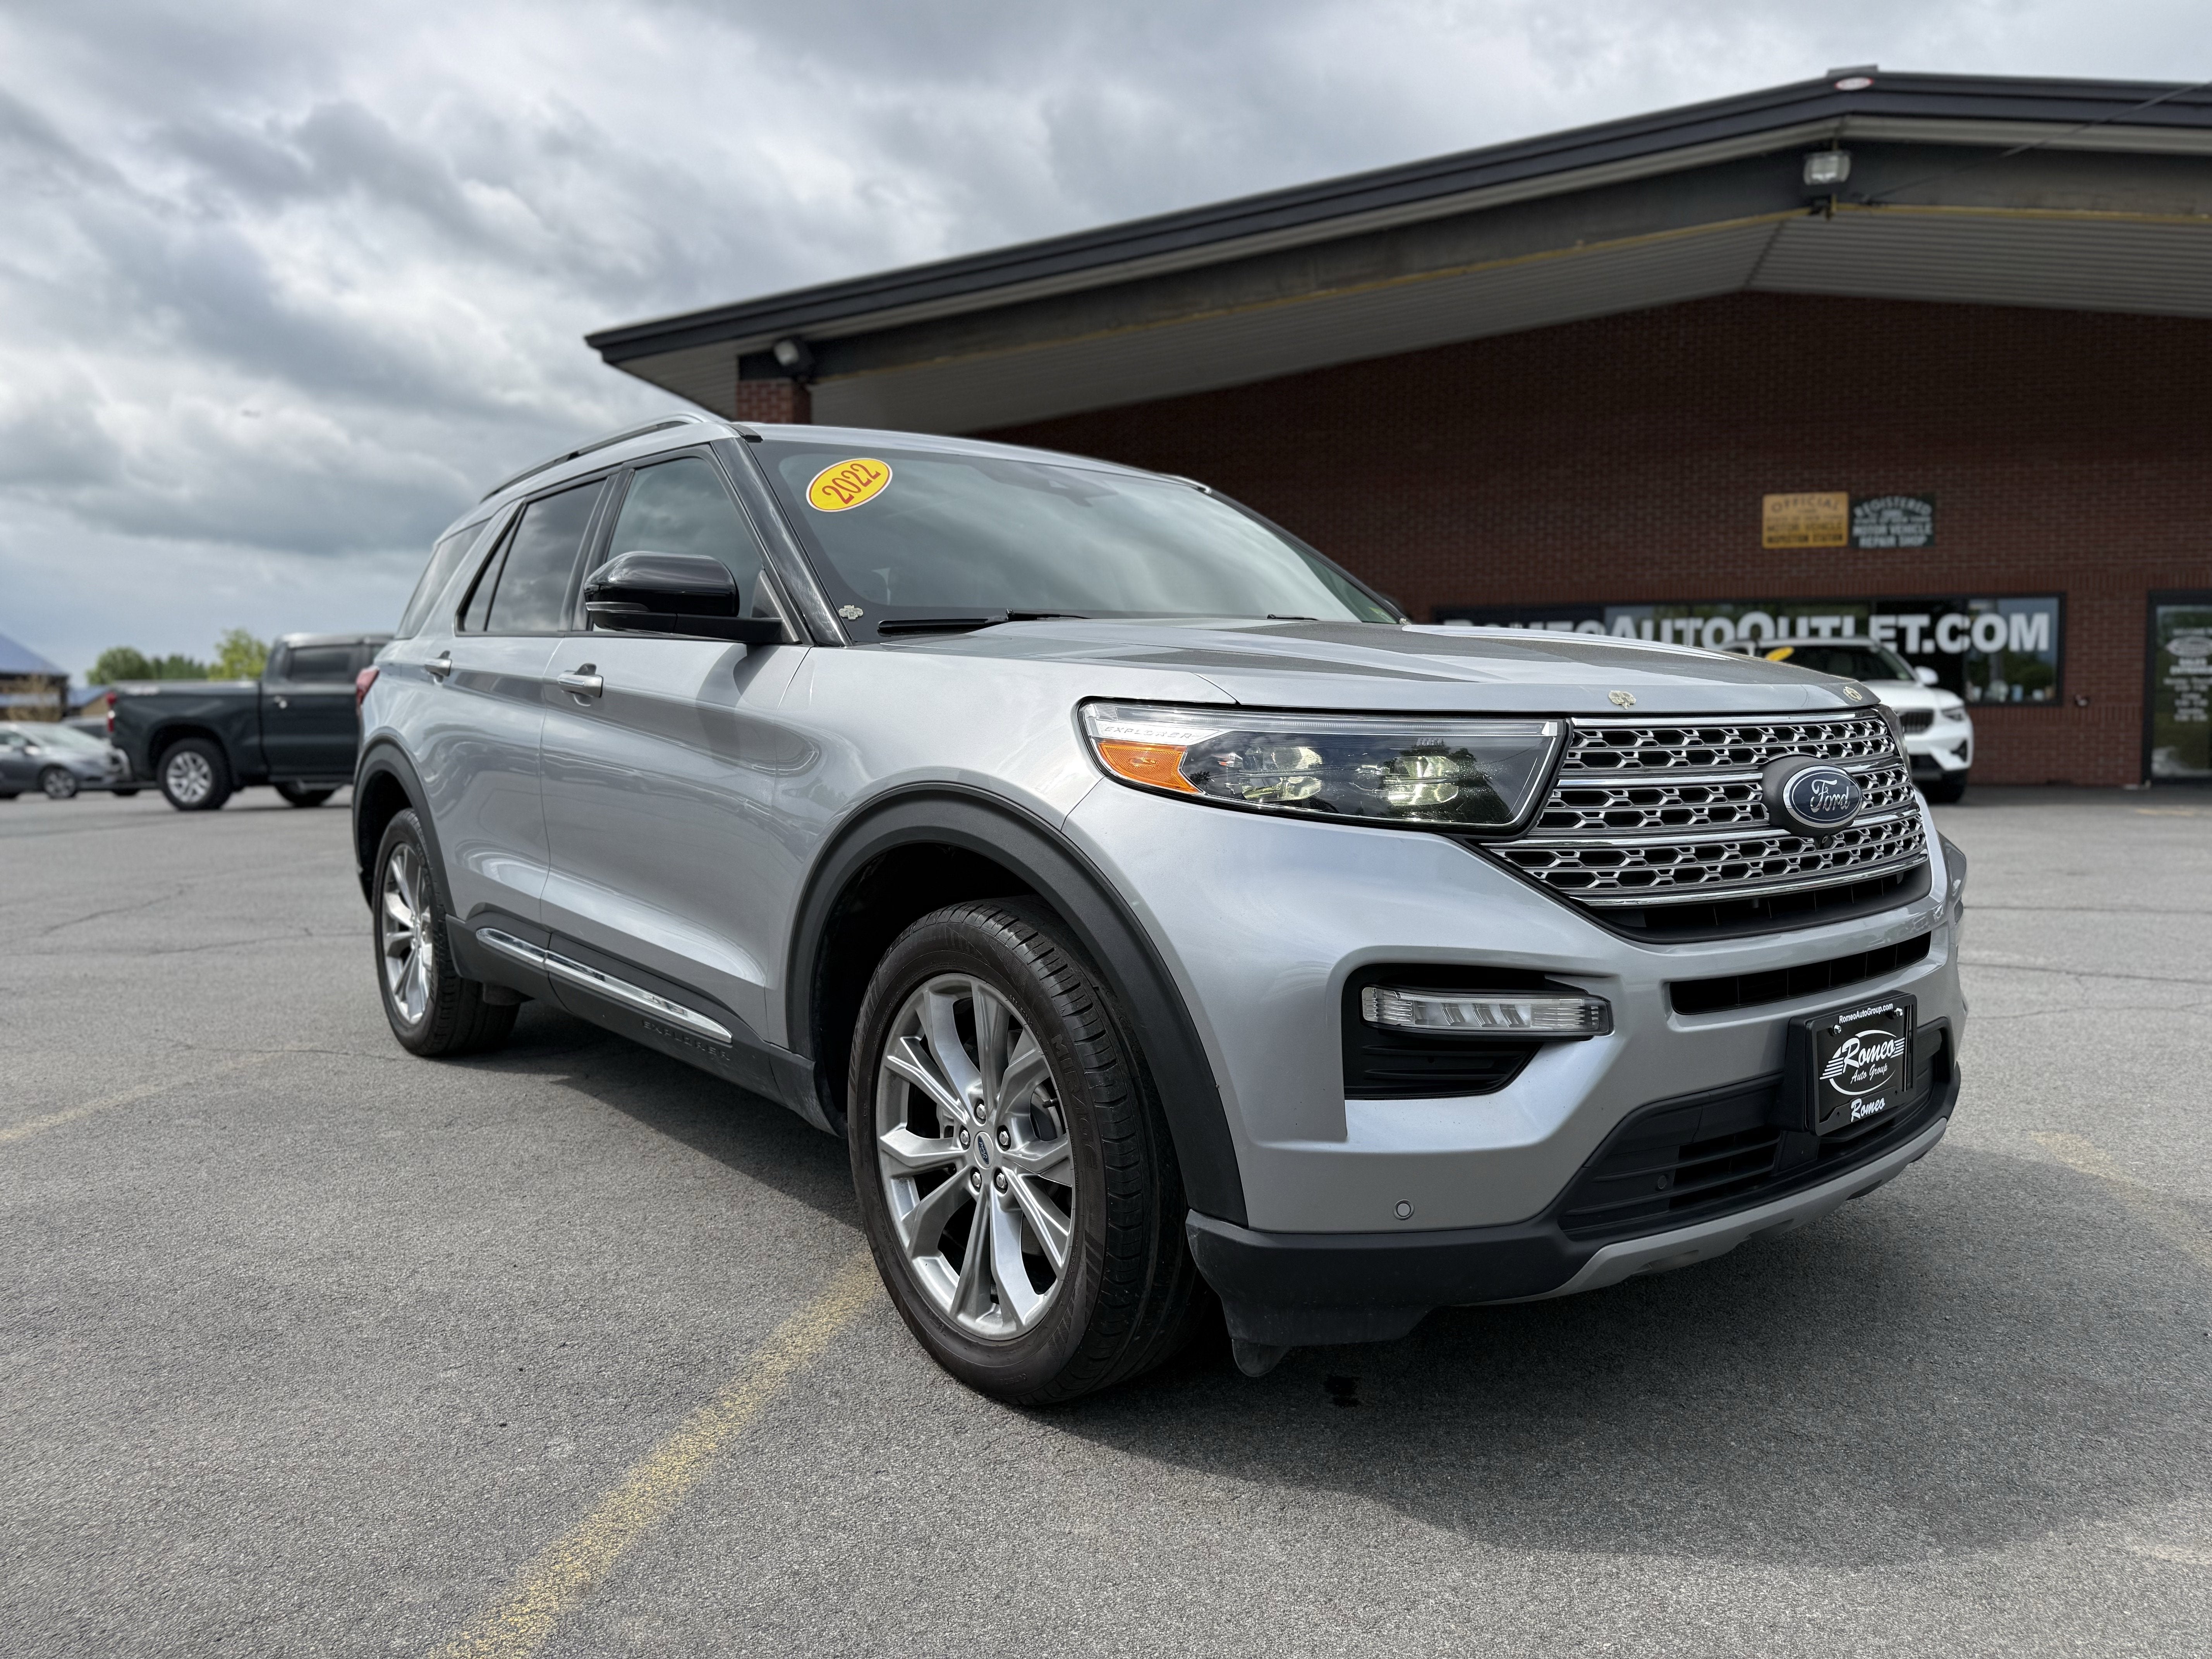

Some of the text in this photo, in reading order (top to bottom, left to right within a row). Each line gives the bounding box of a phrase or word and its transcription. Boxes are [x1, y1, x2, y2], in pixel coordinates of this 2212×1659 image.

[822, 463, 881, 504] 2022
[1444, 611, 2049, 654] AUTOOUTET.COM
[1104, 726, 1193, 739] EXPLORER
[1810, 779, 1850, 813] Ford
[1839, 1003, 1893, 1024] RomeoAutoGroup.com
[642, 1020, 730, 1061] EXPLORER
[1842, 1037, 1896, 1073] Romeo
[1850, 1063, 1888, 1084] Auto Group
[1050, 1034, 1098, 1170] MIRAGE
[1851, 1097, 1885, 1122] Romeo
[979, 1142, 987, 1158] Ford
